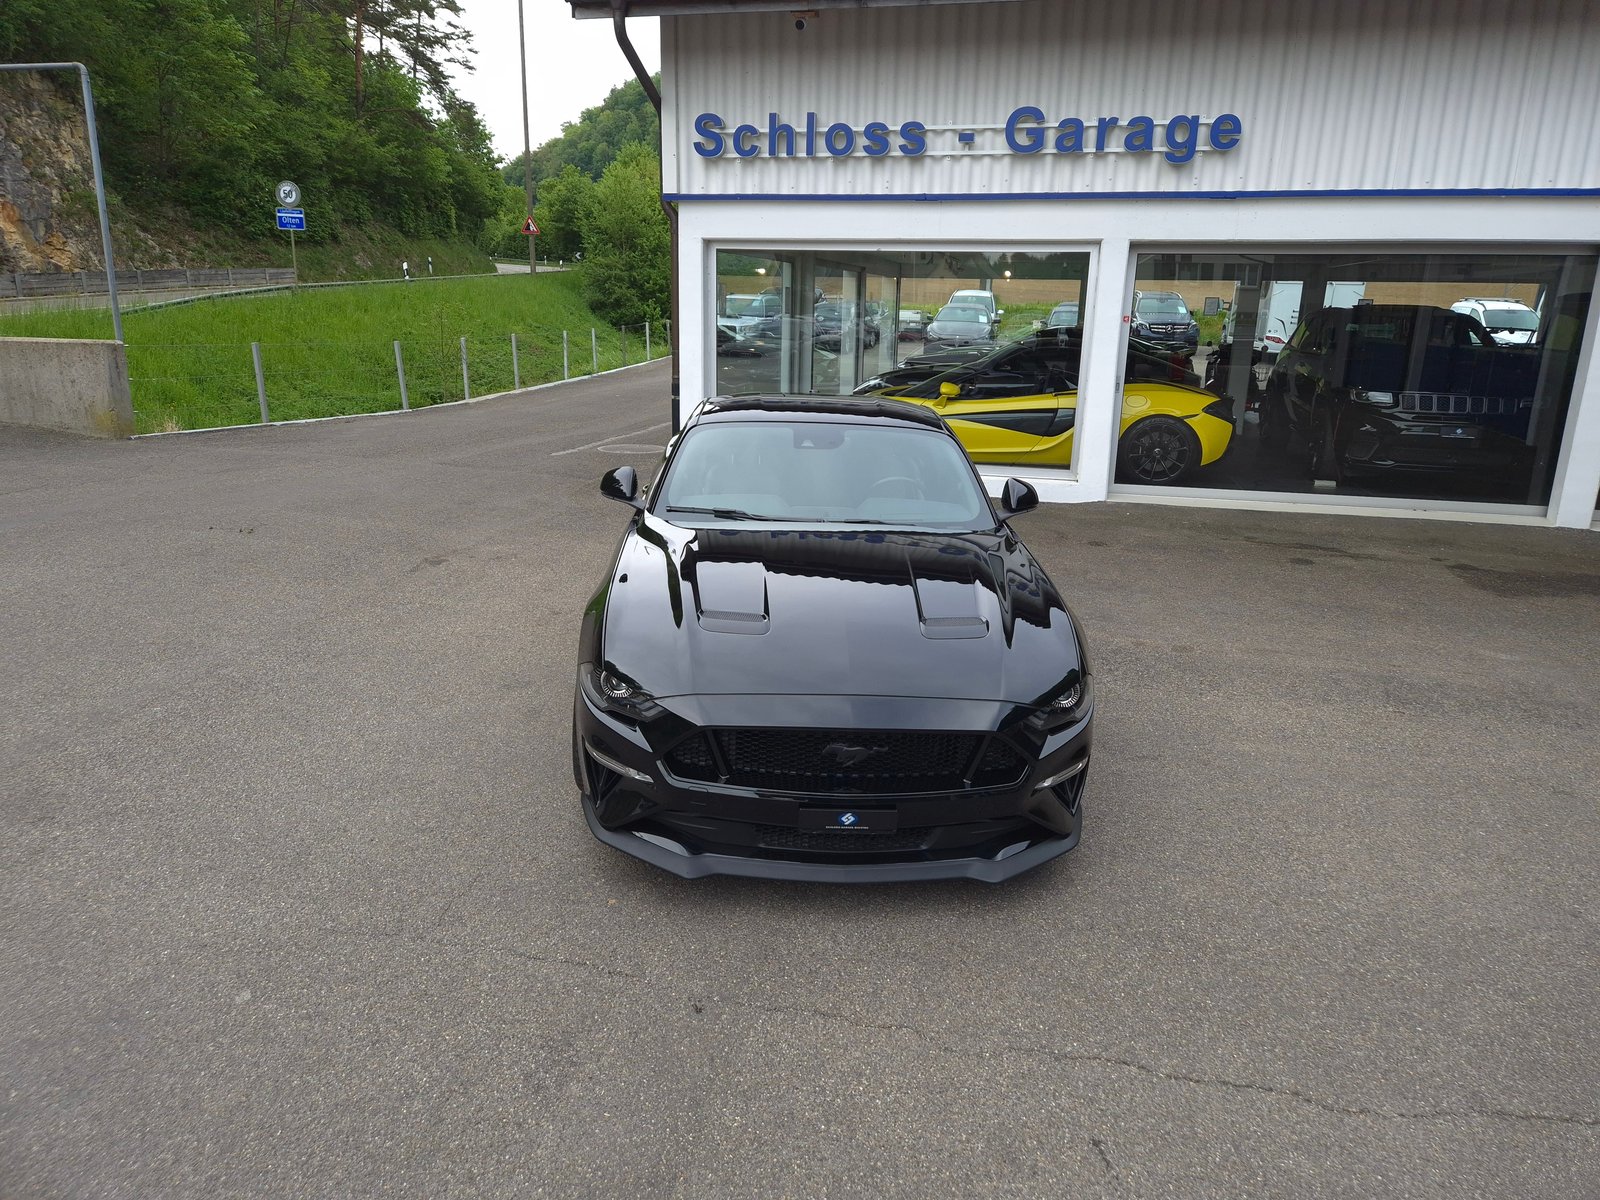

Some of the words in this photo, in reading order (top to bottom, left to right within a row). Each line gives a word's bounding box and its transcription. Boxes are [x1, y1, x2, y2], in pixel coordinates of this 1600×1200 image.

[693, 112, 927, 158] Schloss
[958, 132, 976, 143] -
[1005, 106, 1242, 165] Garage
[283, 190, 293, 199] 50
[282, 216, 300, 224] Olten
